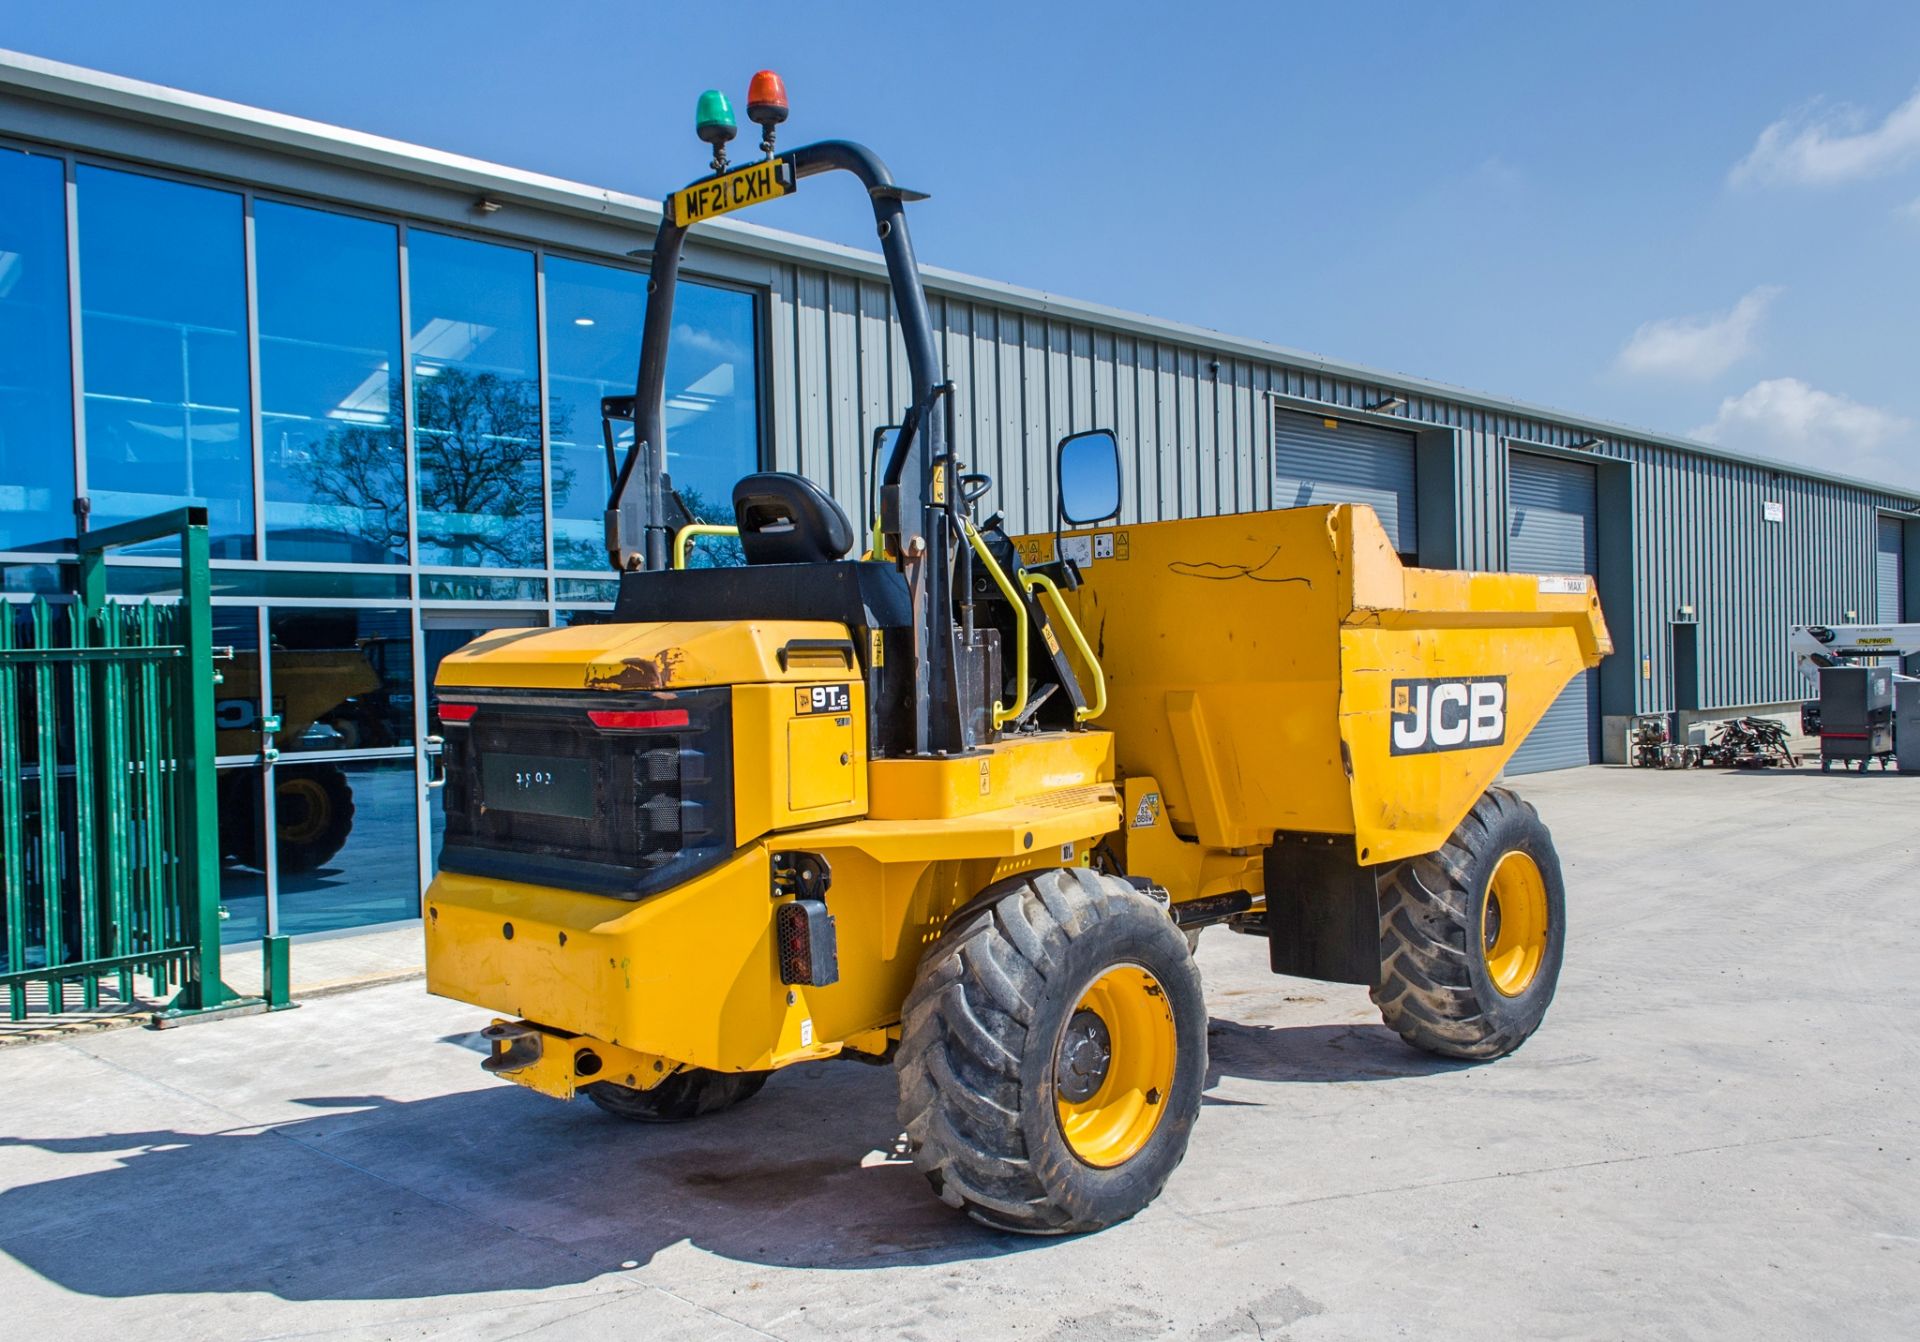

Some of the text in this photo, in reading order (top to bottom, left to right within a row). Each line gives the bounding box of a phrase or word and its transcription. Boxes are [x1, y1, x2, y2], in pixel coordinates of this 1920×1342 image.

[686, 167, 771, 219] MF21 CXH
[1567, 581, 1583, 592] MAX
[1393, 682, 1504, 749] JCB
